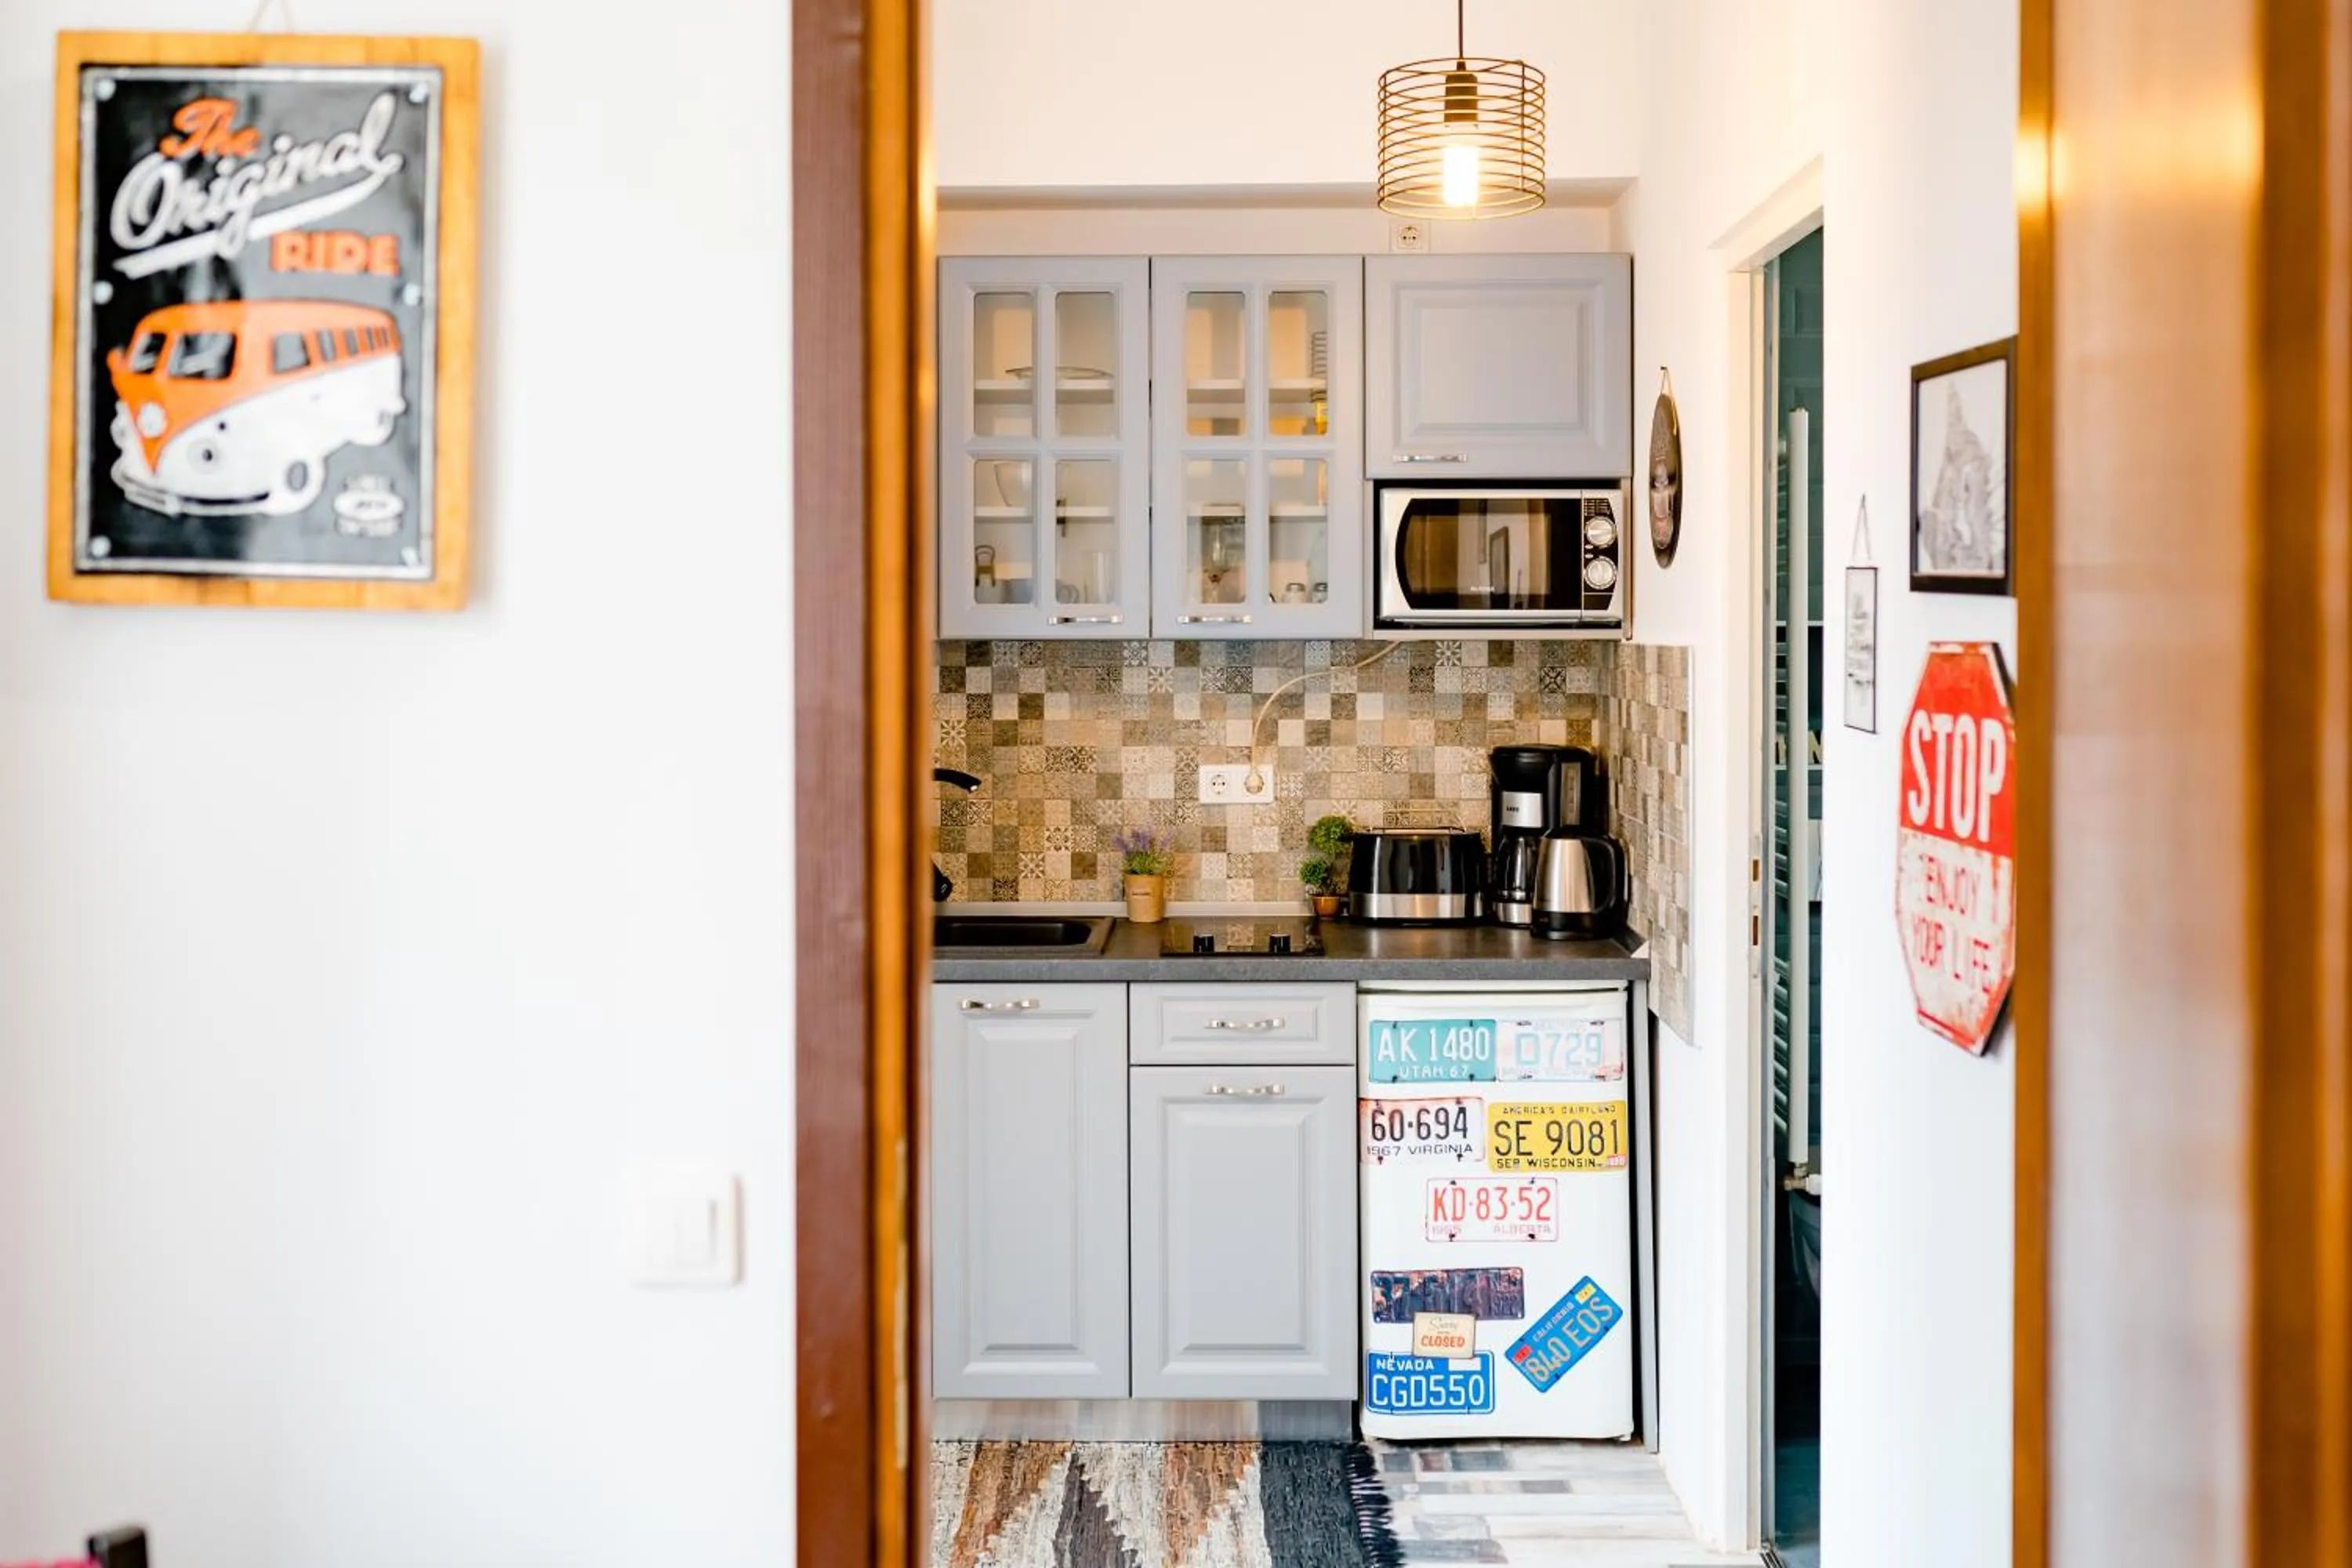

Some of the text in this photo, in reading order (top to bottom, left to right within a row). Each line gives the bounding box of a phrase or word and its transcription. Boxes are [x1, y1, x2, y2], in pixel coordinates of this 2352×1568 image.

[159, 96, 262, 157] The
[110, 92, 403, 260] Original
[270, 228, 400, 276] RIDE
[1907, 708, 2006, 844] STOP
[1377, 1025, 1490, 1062] AK 1480
[1399, 1065, 1469, 1079] UTAH 67
[1503, 1105, 1555, 1115] AMERICA'S
[1407, 1142, 1473, 1156] VIRGINIA
[1494, 1119, 1618, 1157] SE 9081
[1526, 1158, 1596, 1168] WISCONSIN
[1561, 1297, 1613, 1348] EOS
[1420, 1334, 1465, 1348] CLOSED
[1376, 1357, 1435, 1371] NEVADA
[1372, 1374, 1485, 1408] CGD550
